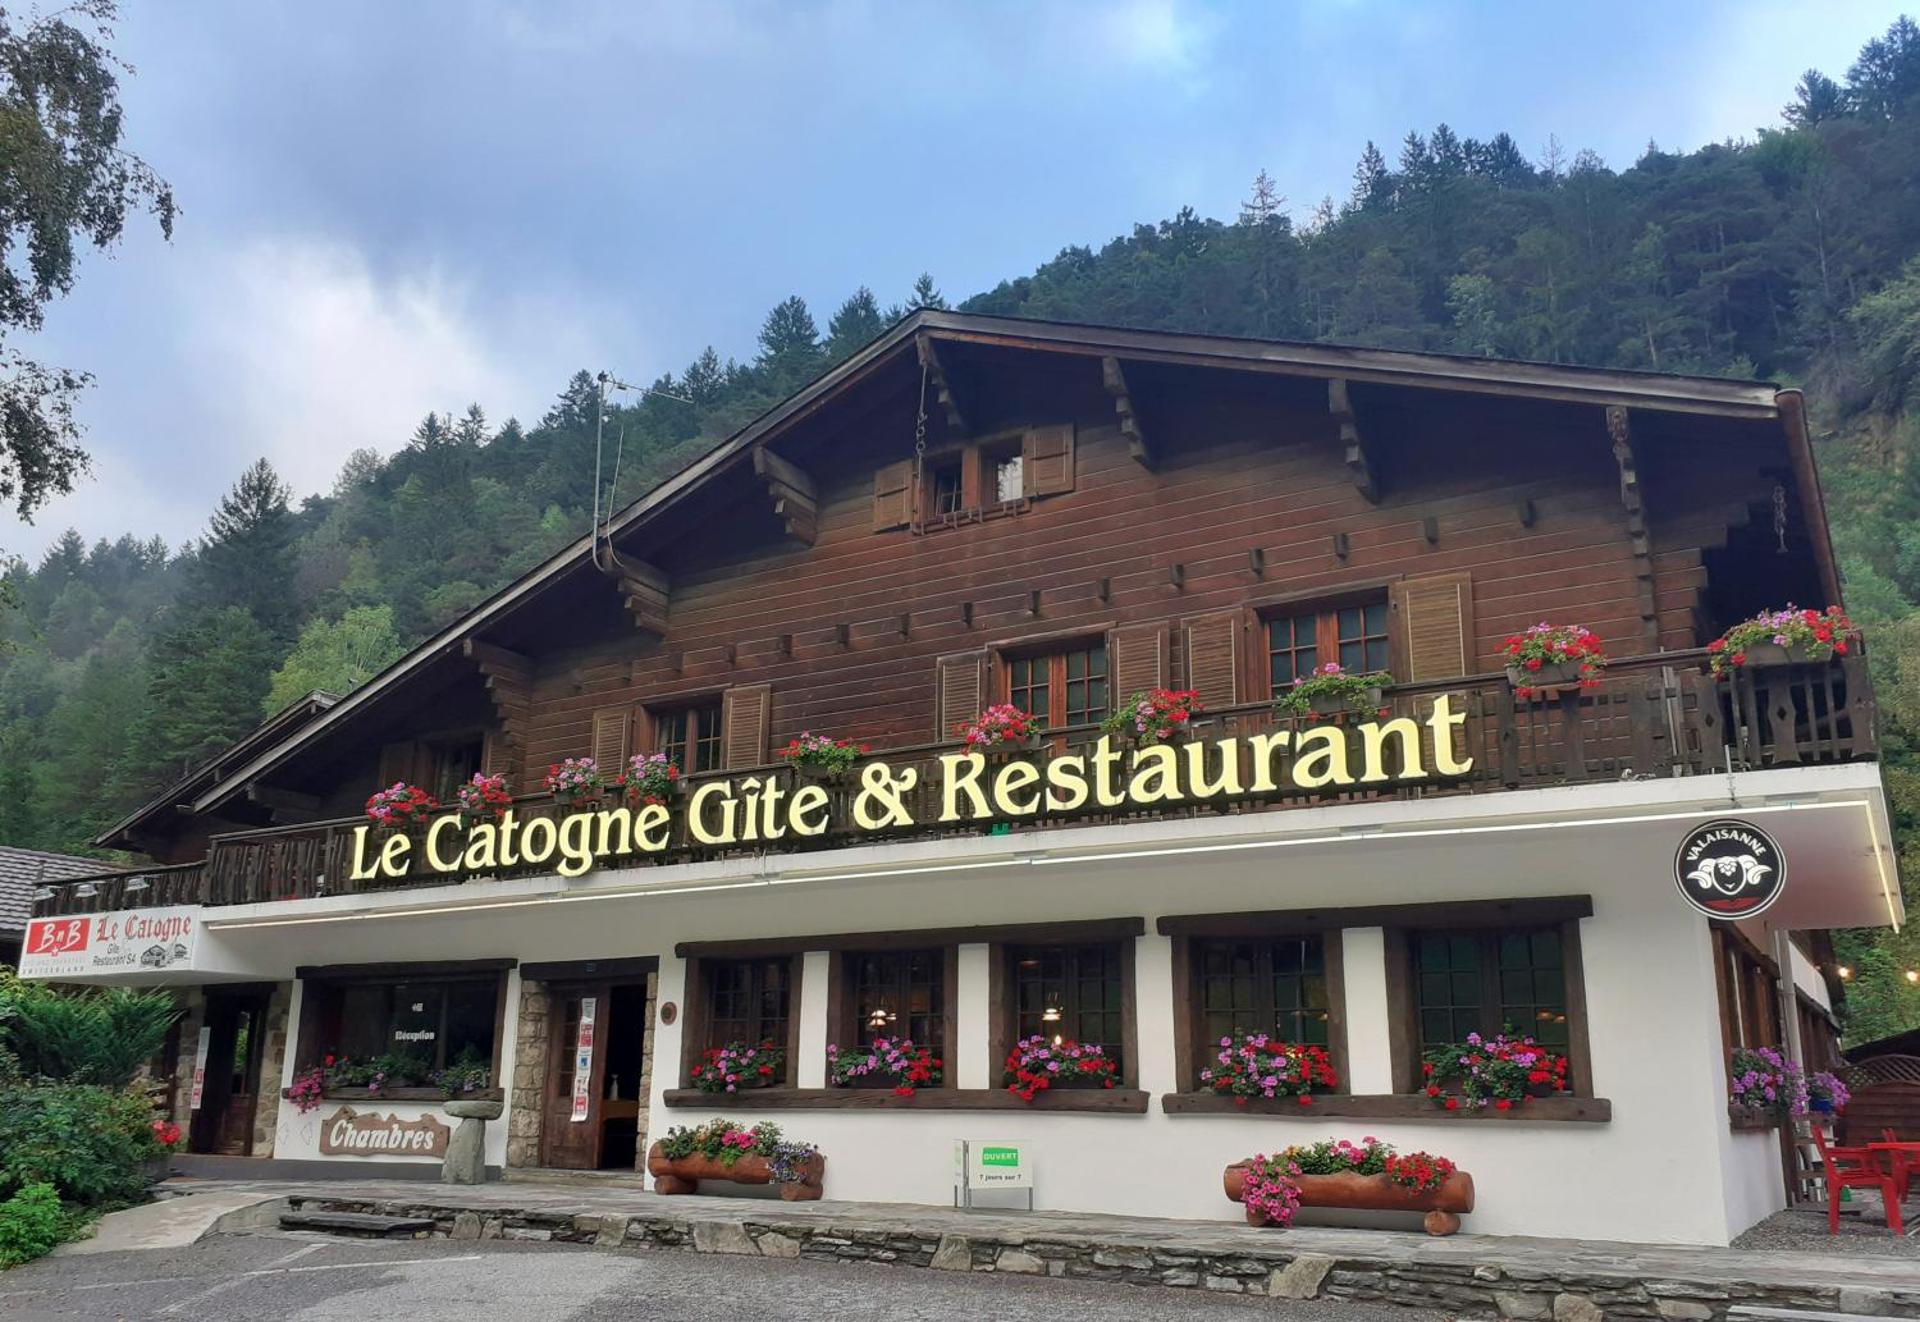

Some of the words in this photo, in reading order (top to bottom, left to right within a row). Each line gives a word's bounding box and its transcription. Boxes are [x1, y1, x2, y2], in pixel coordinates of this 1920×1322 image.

[350, 825, 412, 880] Le
[426, 803, 671, 877] Catogne
[688, 774, 830, 845] Gîte
[852, 761, 918, 831] &
[938, 694, 1475, 822] Restaurant
[1686, 829, 1767, 861] VALAISANNE
[96, 915, 119, 942] Le
[125, 913, 193, 943] Catogne
[329, 1119, 435, 1150] Chambres
[983, 1152, 1018, 1161] OUVERT
[985, 1174, 1003, 1182] jours
